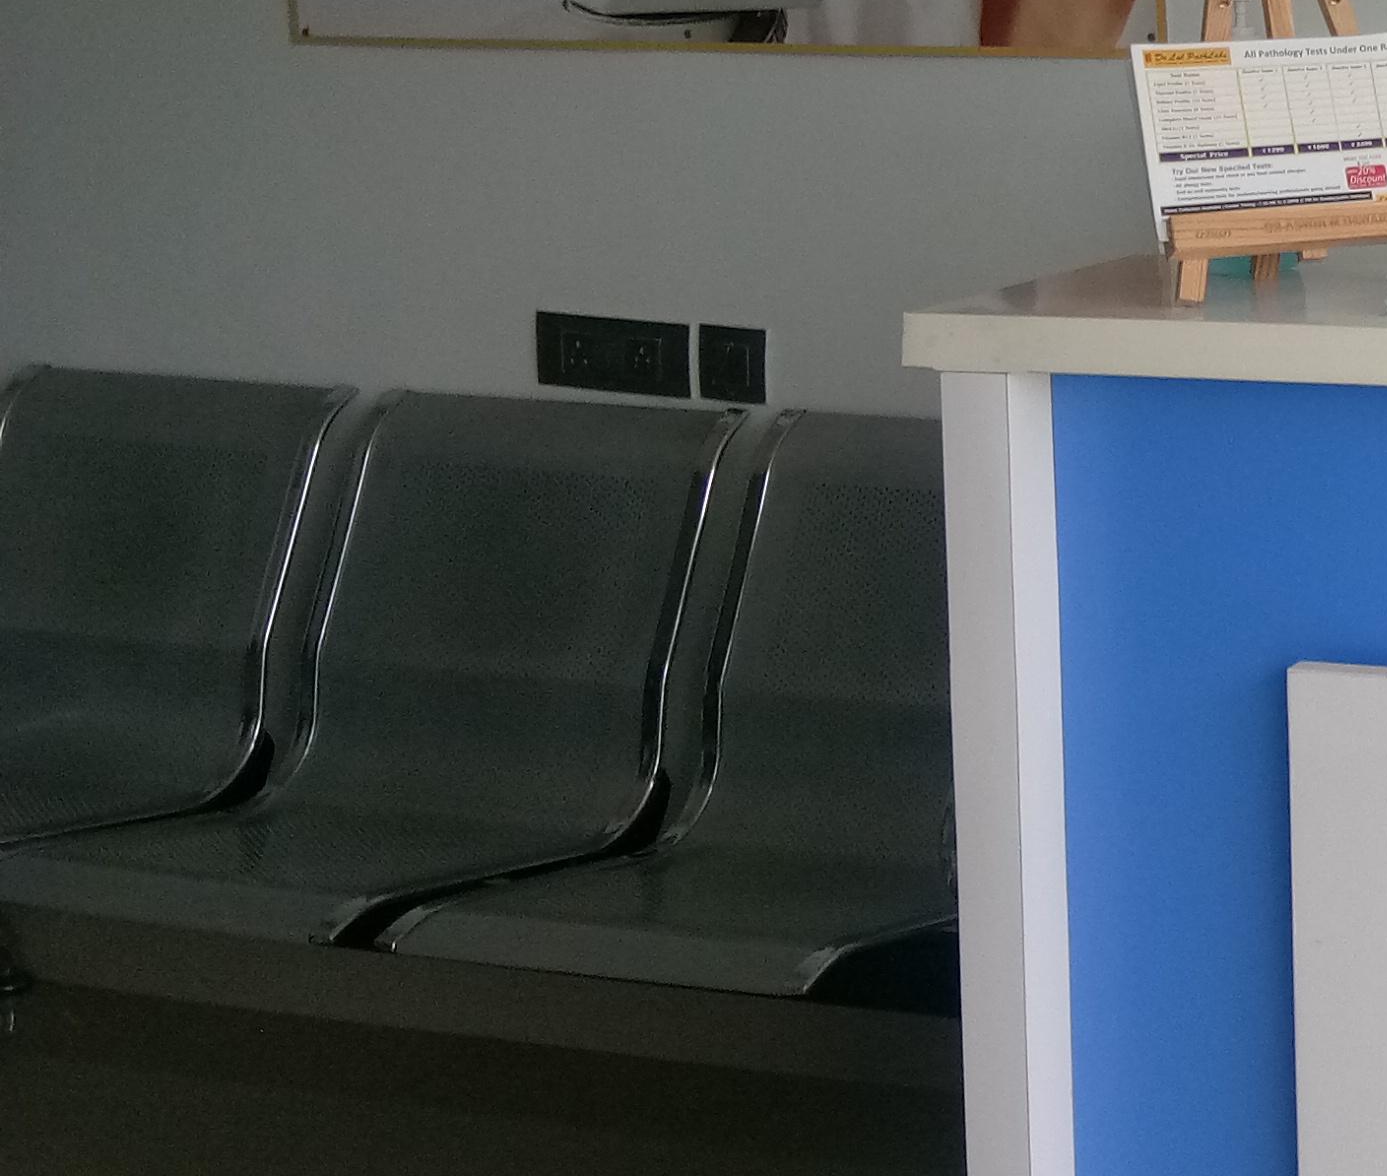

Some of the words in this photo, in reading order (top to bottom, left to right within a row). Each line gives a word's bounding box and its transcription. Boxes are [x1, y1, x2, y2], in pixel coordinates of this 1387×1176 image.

[1244, 49, 1257, 58] All
[1258, 47, 1303, 58] Pathology
[1305, 47, 1328, 57] Tests
[1329, 45, 1357, 55] Under
[1359, 44, 1378, 53] One
[1350, 172, 1386, 185] Discount
